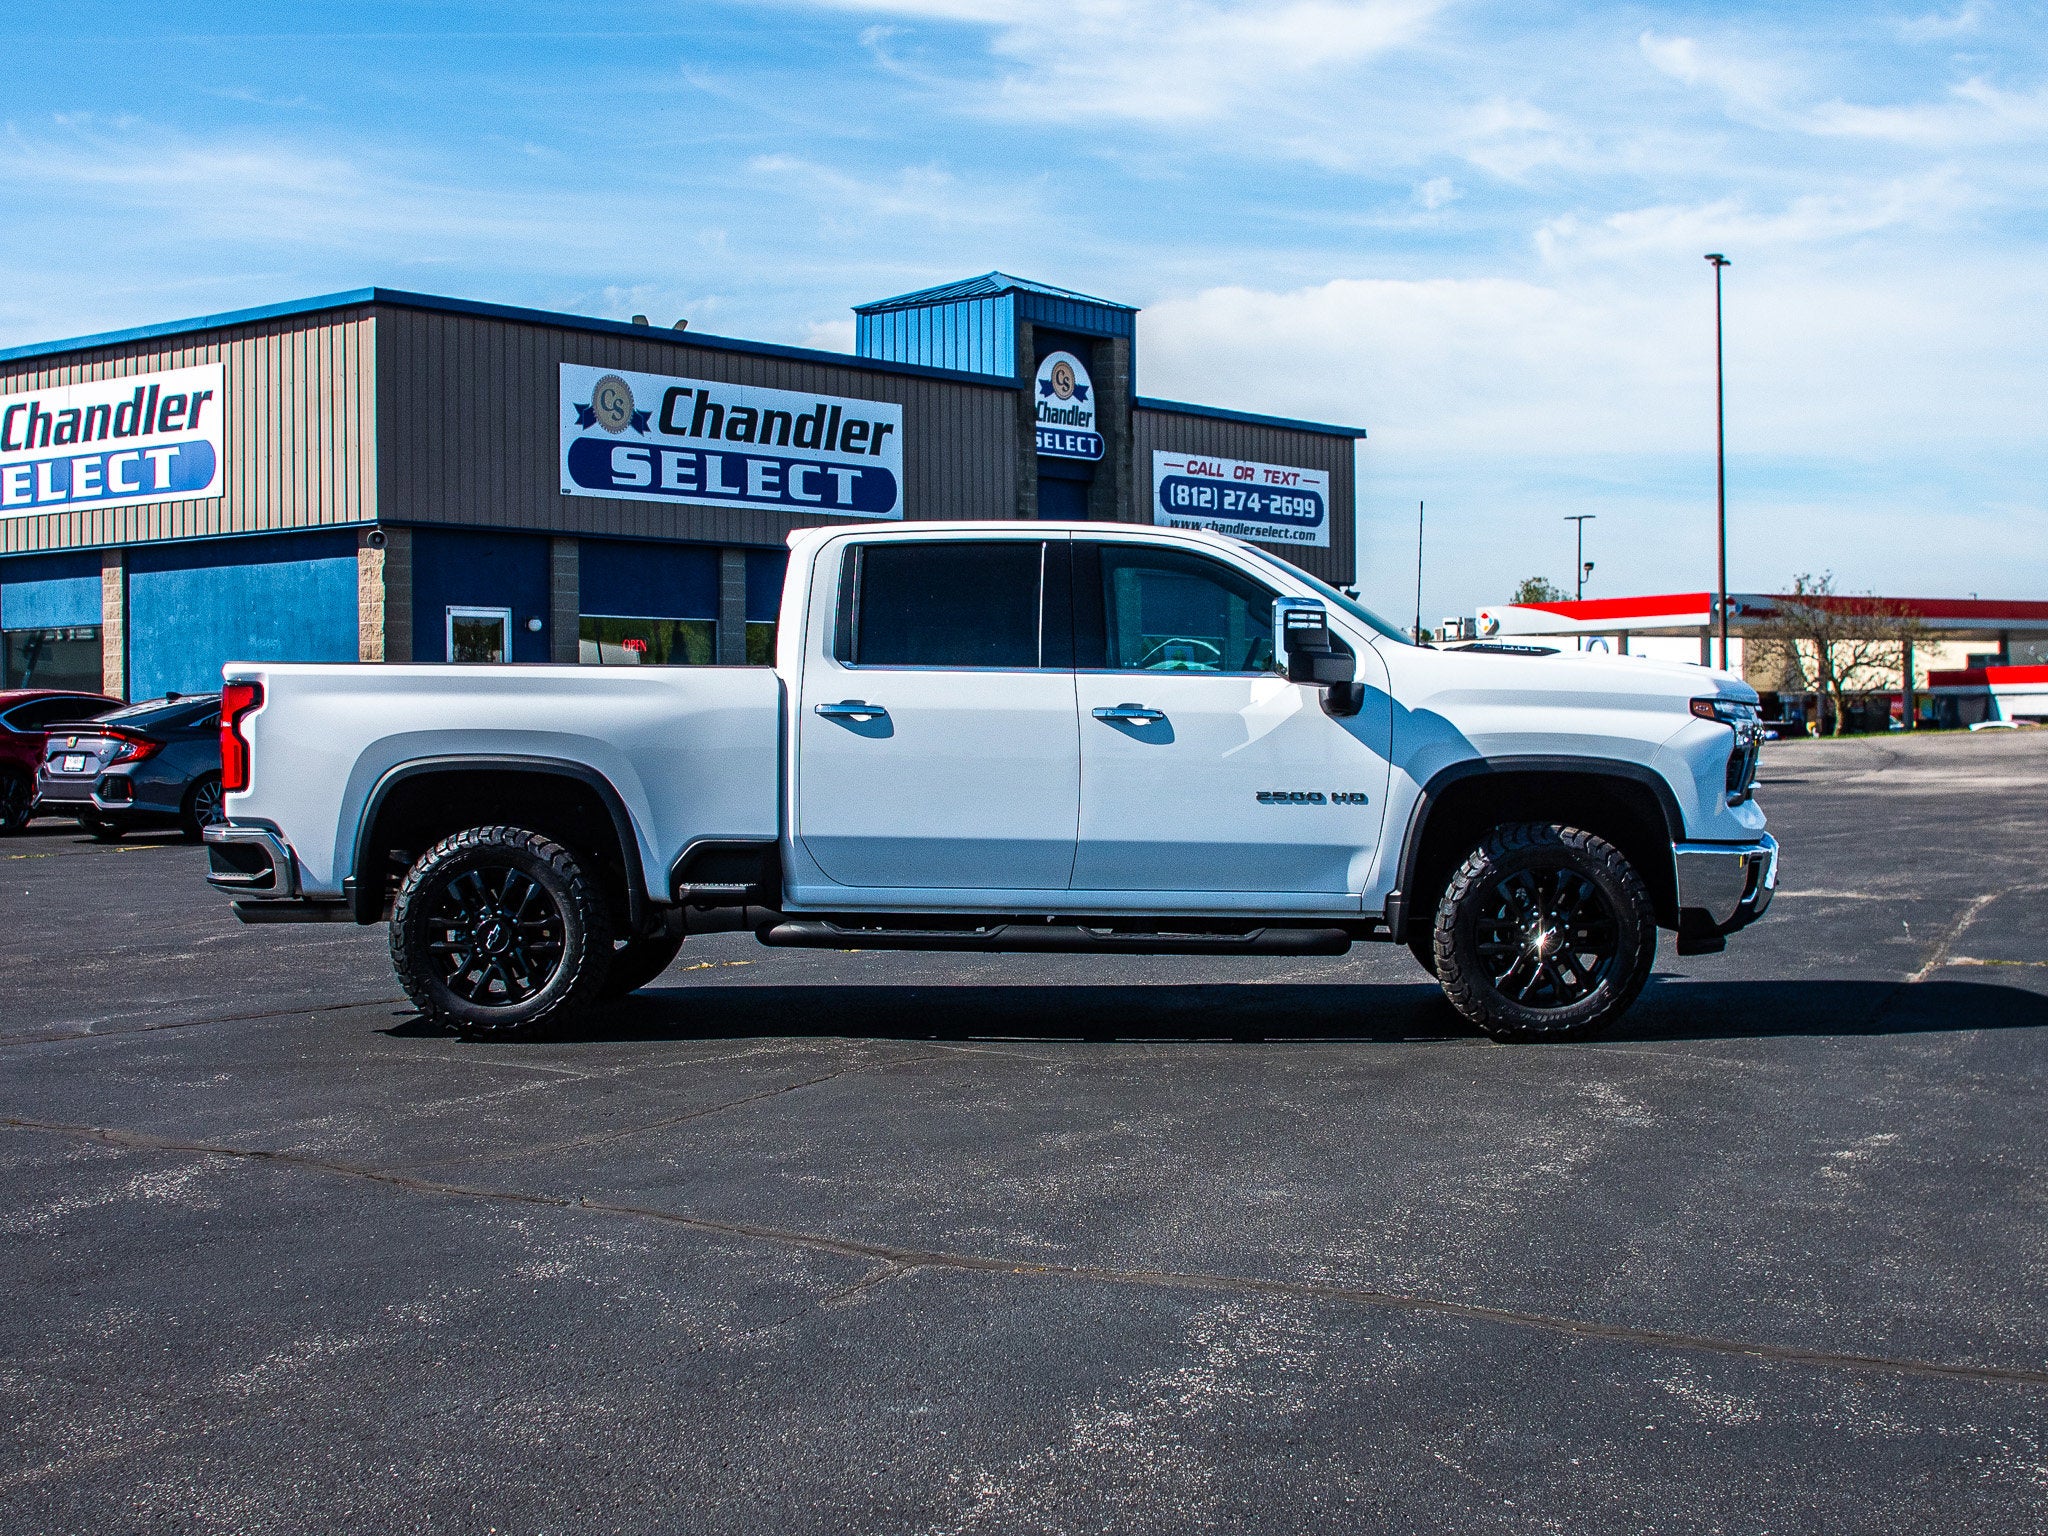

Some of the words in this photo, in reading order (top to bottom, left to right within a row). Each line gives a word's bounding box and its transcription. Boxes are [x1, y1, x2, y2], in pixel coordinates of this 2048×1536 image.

[0, 384, 213, 451] Chandler
[601, 389, 624, 421] CS
[658, 386, 894, 456] Chandler
[1036, 401, 1092, 427] Chandler
[611, 446, 863, 504] SELECT
[1186, 460, 1224, 477] CALL
[1233, 465, 1255, 481] OR
[1263, 469, 1300, 486] TEXT
[1170, 483, 1218, 510] (812)
[1223, 489, 1316, 518] 274-2699
[622, 639, 647, 652] OPEN
[1256, 791, 1324, 802] 2500
[1331, 792, 1367, 803] HD
